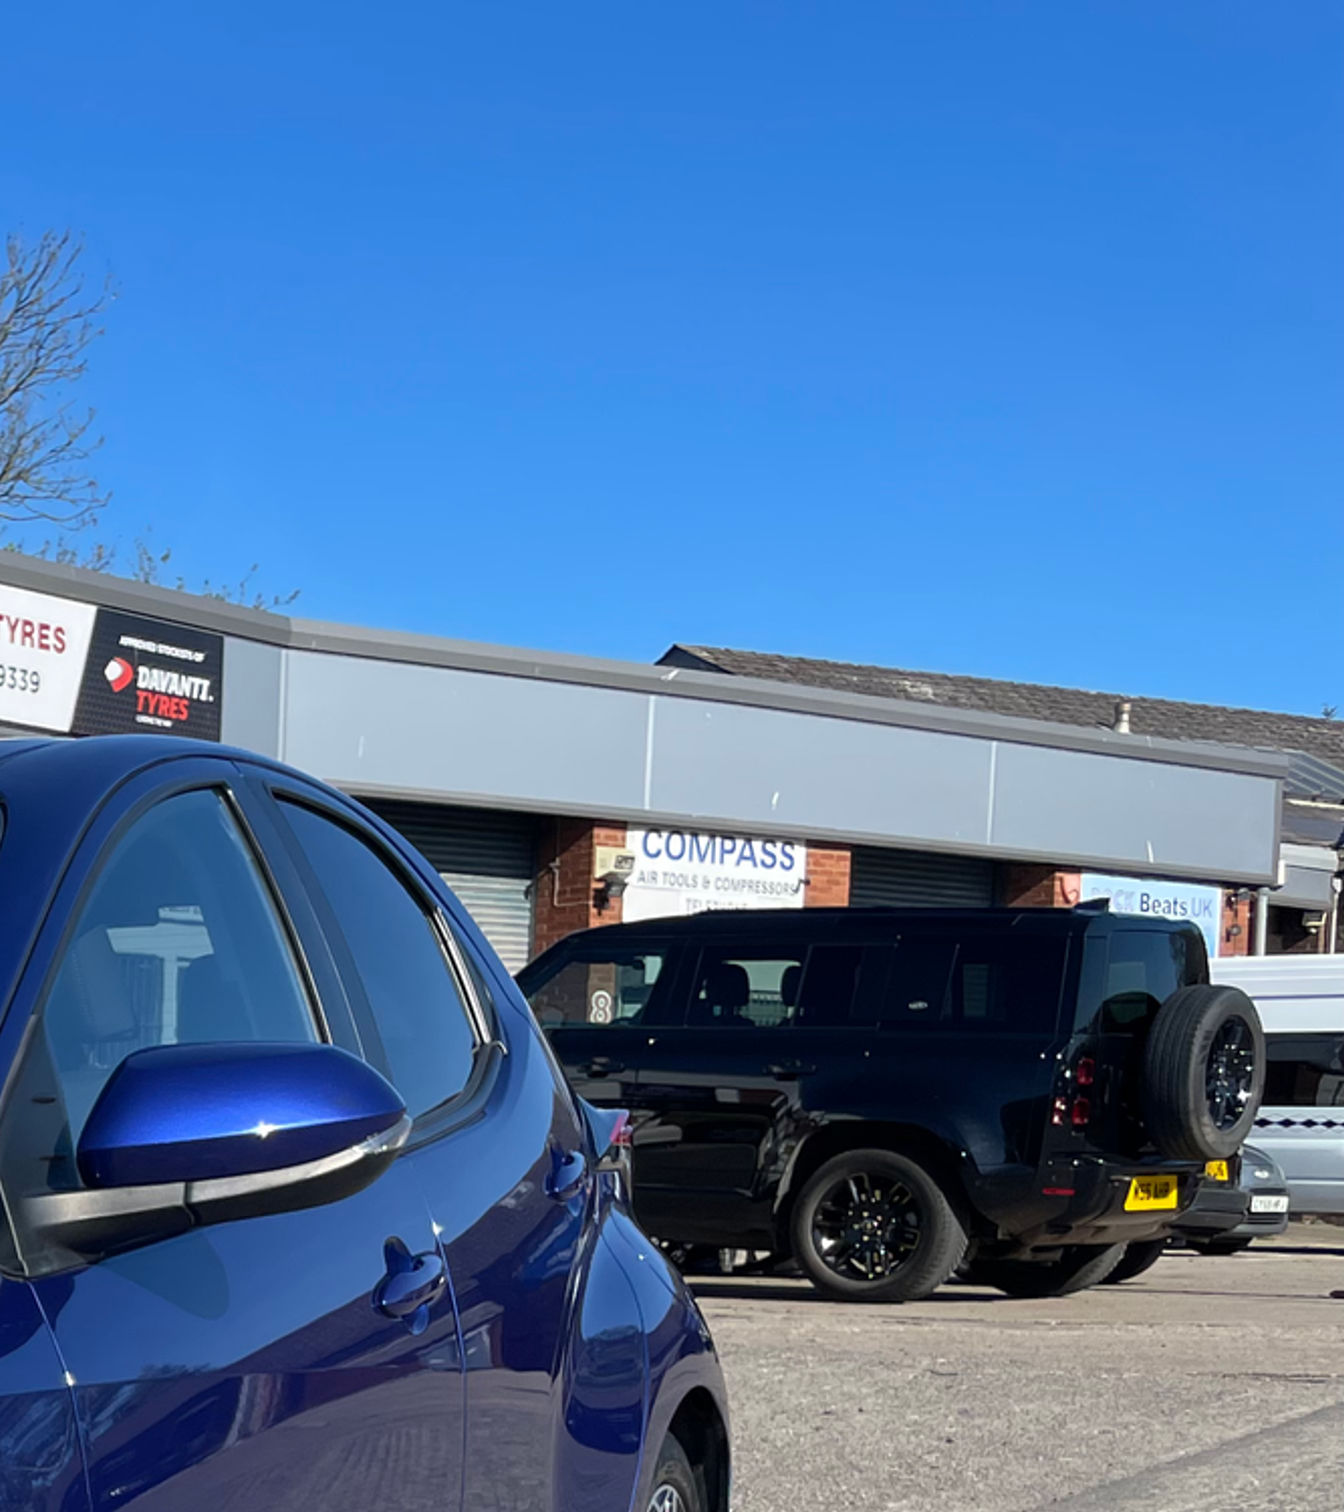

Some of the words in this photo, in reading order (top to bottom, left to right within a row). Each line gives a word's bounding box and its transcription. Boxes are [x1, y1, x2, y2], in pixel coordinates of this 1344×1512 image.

[136, 690, 189, 720] TYRES
[642, 829, 795, 871] COMPASS
[637, 871, 658, 885] AIR
[663, 872, 698, 889] TOOLS
[702, 879, 711, 890] &
[715, 877, 796, 897] COMPRESSORS
[1140, 893, 1188, 917] Beats
[1191, 898, 1213, 918] UK
[590, 990, 612, 1023] 8
